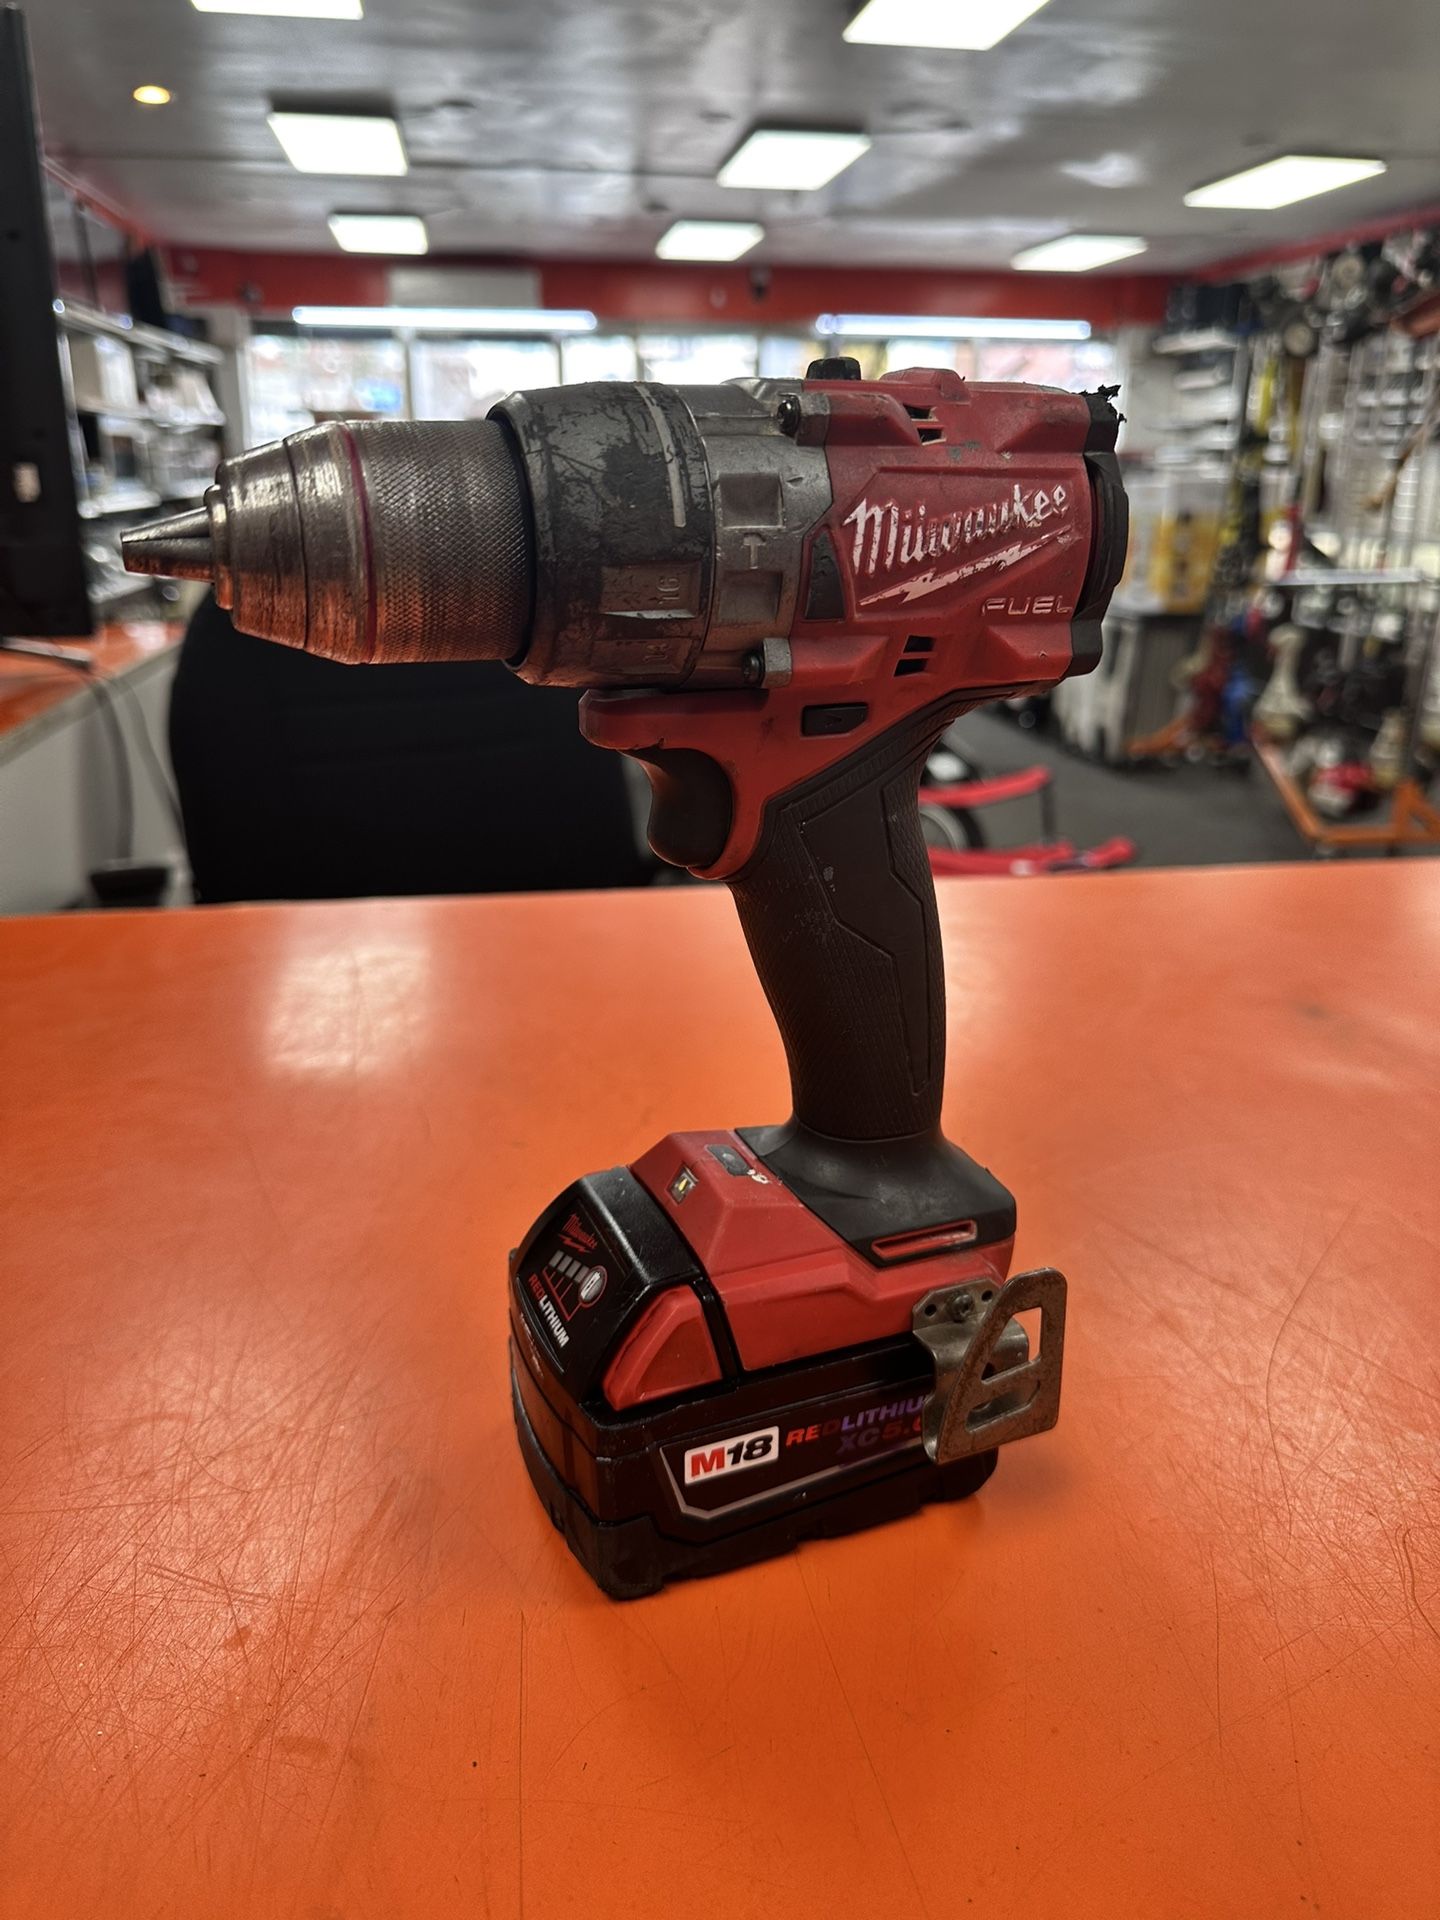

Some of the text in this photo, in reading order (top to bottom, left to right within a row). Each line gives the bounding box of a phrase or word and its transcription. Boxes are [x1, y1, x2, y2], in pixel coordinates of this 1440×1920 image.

[982, 595, 1074, 617] FUEL
[527, 1273, 571, 1349] REDLITHIUM
[785, 1394, 926, 1448] REDLITHIU
[690, 1433, 774, 1478] M18
